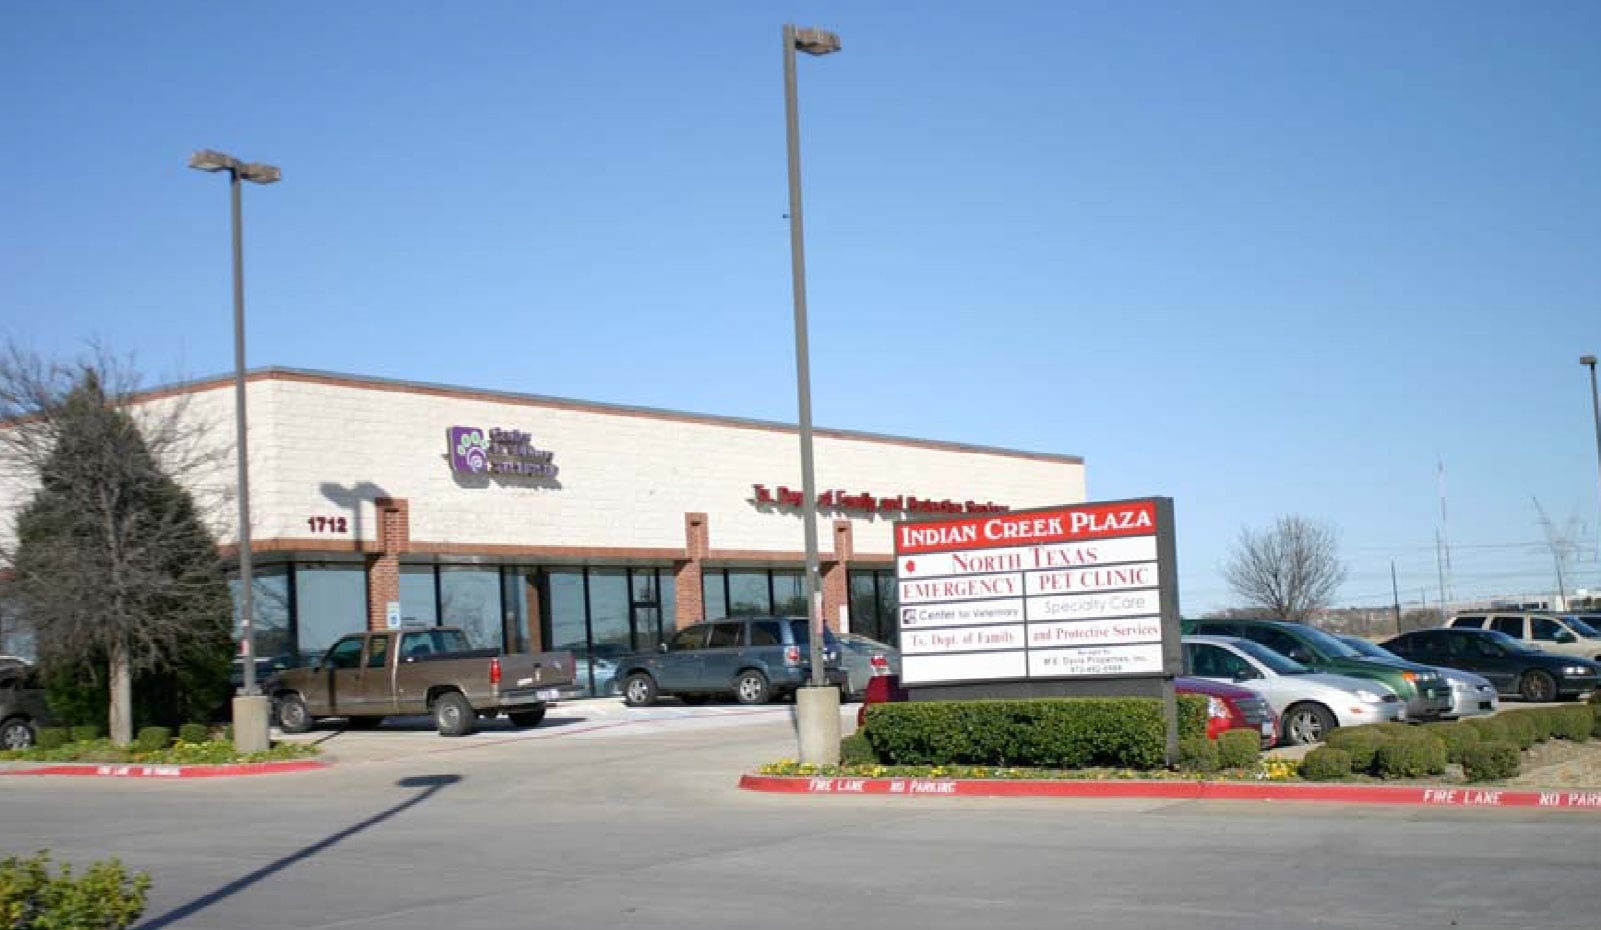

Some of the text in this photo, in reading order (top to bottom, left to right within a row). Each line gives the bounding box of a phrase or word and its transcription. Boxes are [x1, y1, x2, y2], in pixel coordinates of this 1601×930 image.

[308, 516, 348, 533] 1712
[902, 509, 1152, 548] INDIAN CREEK PLAZA
[952, 546, 1098, 574] NORTH TEXAS
[903, 577, 1015, 599] EMERGENCY
[1039, 567, 1149, 591] PET CLINIC
[1044, 596, 1145, 614] Specialty Care
[963, 632, 973, 644] of
[1033, 623, 1159, 642] and Protective Services
[1423, 789, 1457, 804] FIRE
[1462, 791, 1503, 805] LANE
[1539, 791, 1560, 806] NO
